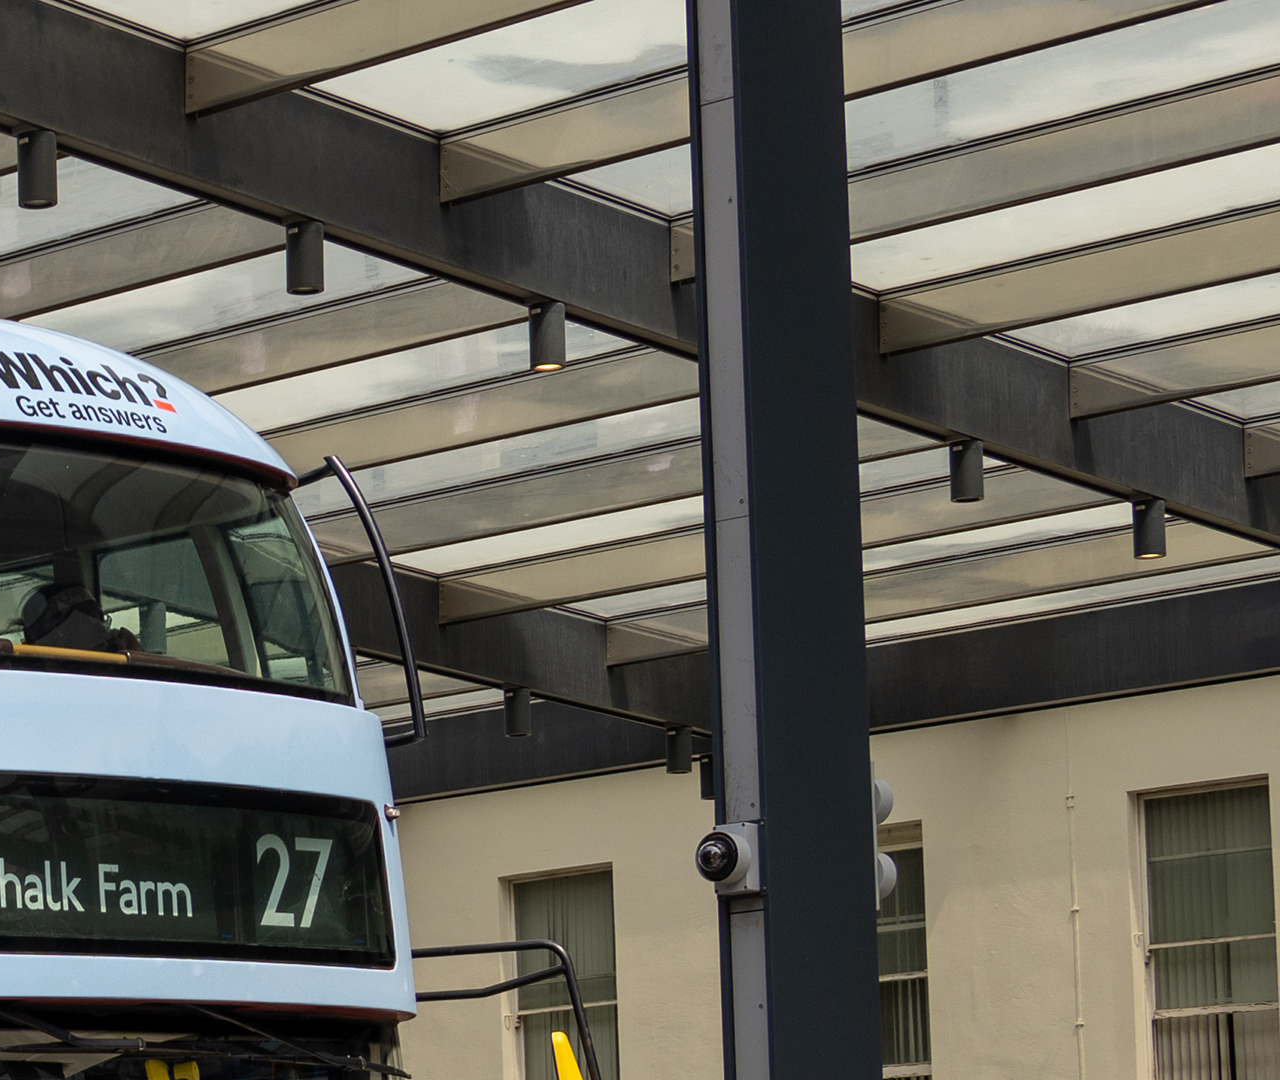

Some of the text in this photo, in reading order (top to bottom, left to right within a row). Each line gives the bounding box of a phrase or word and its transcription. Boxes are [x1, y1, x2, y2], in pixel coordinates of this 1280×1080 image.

[15, 395, 168, 434] Get answers
[96, 863, 194, 918] Farm
[255, 833, 334, 929] 27
